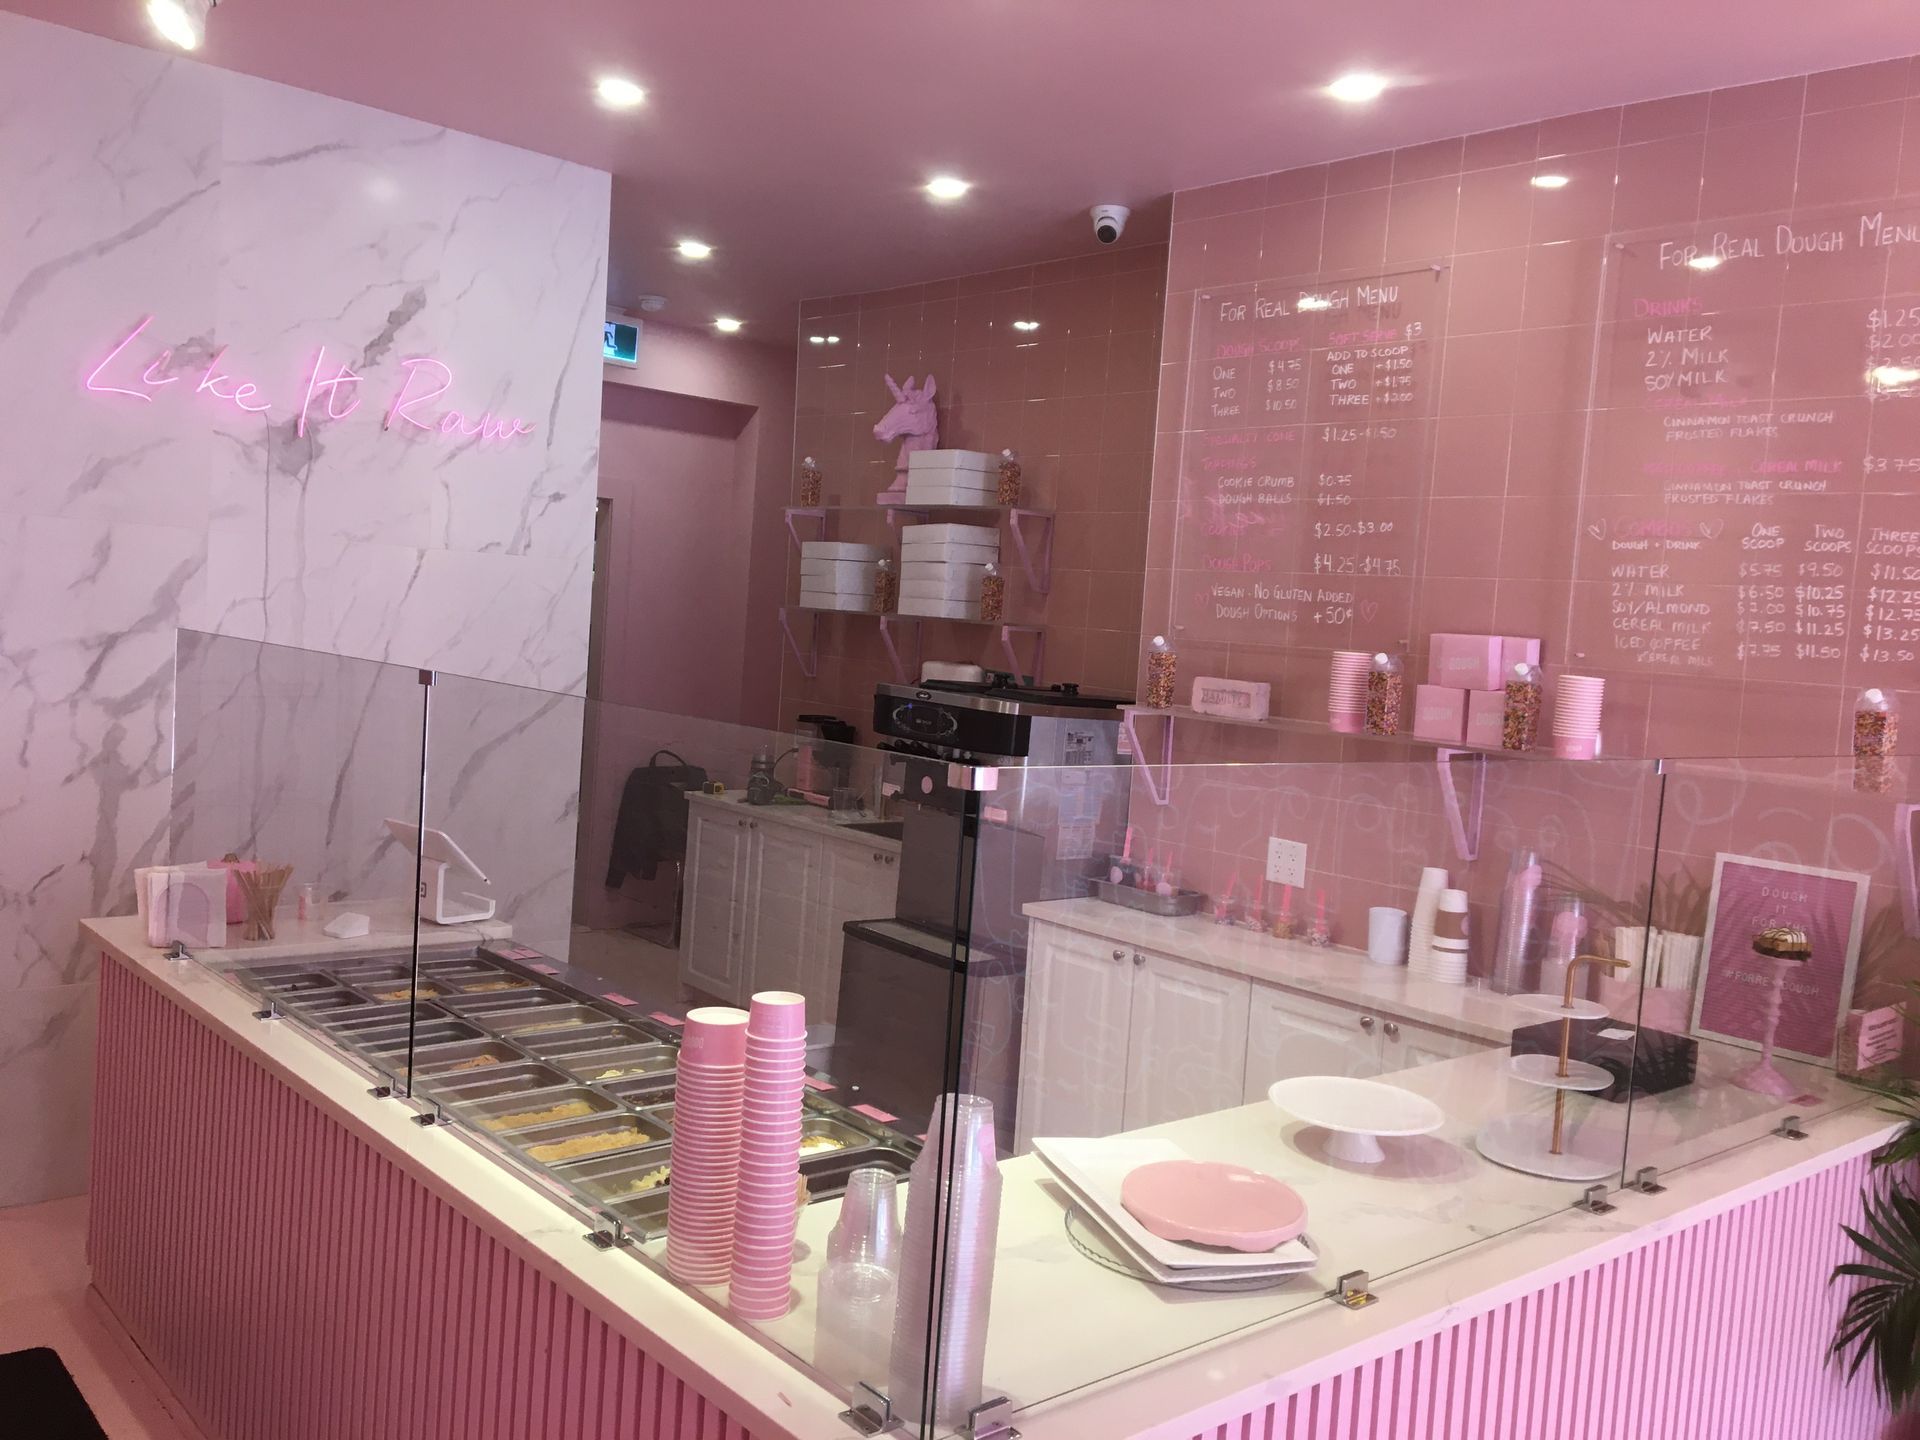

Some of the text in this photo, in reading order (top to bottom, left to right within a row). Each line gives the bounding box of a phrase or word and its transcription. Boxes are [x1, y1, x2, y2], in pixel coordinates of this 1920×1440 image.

[1659, 241, 1698, 270] FOR
[1713, 231, 1765, 260] REAL
[1776, 224, 1843, 254] DOUGH
[1220, 301, 1246, 320] FOR
[1256, 297, 1290, 318] REAL
[1357, 285, 1399, 306] MENU
[1404, 321, 1422, 341] $3
[1647, 324, 1713, 345] WATER
[1327, 350, 1352, 362] ADD
[1354, 349, 1368, 360] TO
[1645, 350, 1672, 369] 2%
[1681, 347, 1729, 366] MILK
[1213, 365, 1237, 381] ONE
[1331, 362, 1355, 376] ONE
[86, 315, 536, 442] Like It Raw
[1330, 378, 1357, 391] TWO
[1677, 369, 1729, 387] MILK
[1213, 386, 1236, 400] TWO
[1329, 393, 1370, 407] THREE
[1211, 403, 1241, 418] THREE
[1736, 413, 1774, 425] TOAST
[1779, 410, 1835, 424] CRUNCH
[1729, 426, 1779, 438] FLAKES
[1217, 475, 1253, 489] COOKIE
[1257, 474, 1295, 488] CRUMB
[1738, 480, 1773, 491] TOAST
[1778, 479, 1827, 492] CRUNCH
[1218, 493, 1253, 505] DOUGH
[1257, 492, 1293, 504] BALLS
[1724, 494, 1774, 506] FLAKES
[1751, 521, 1920, 543] ONE TWO THREE
[1611, 540, 1649, 551] DOUGH
[1665, 539, 1701, 551] DRINK
[1741, 536, 1785, 550] SCOOP
[1804, 540, 1853, 553] SCOOPS
[1611, 563, 1671, 579] WATER
[1799, 562, 1843, 577] $9.50
[1211, 582, 1245, 598] VEGAN
[1254, 580, 1270, 599] NO
[1273, 584, 1312, 602] GLUTEN
[1317, 588, 1353, 604] ADDED
[1644, 583, 1685, 598] MILK
[1738, 584, 1784, 599] $6.50
[1795, 582, 1845, 603] $10.25
[1215, 602, 1249, 619] DOUGH
[1254, 602, 1298, 622] OPTIONS
[1612, 617, 1664, 632] CEREAL
[1671, 621, 1712, 635] MILK
[1860, 643, 1914, 663] $13.50
[1761, 886, 1808, 903] DOUGH
[1751, 916, 1777, 929] FOR
